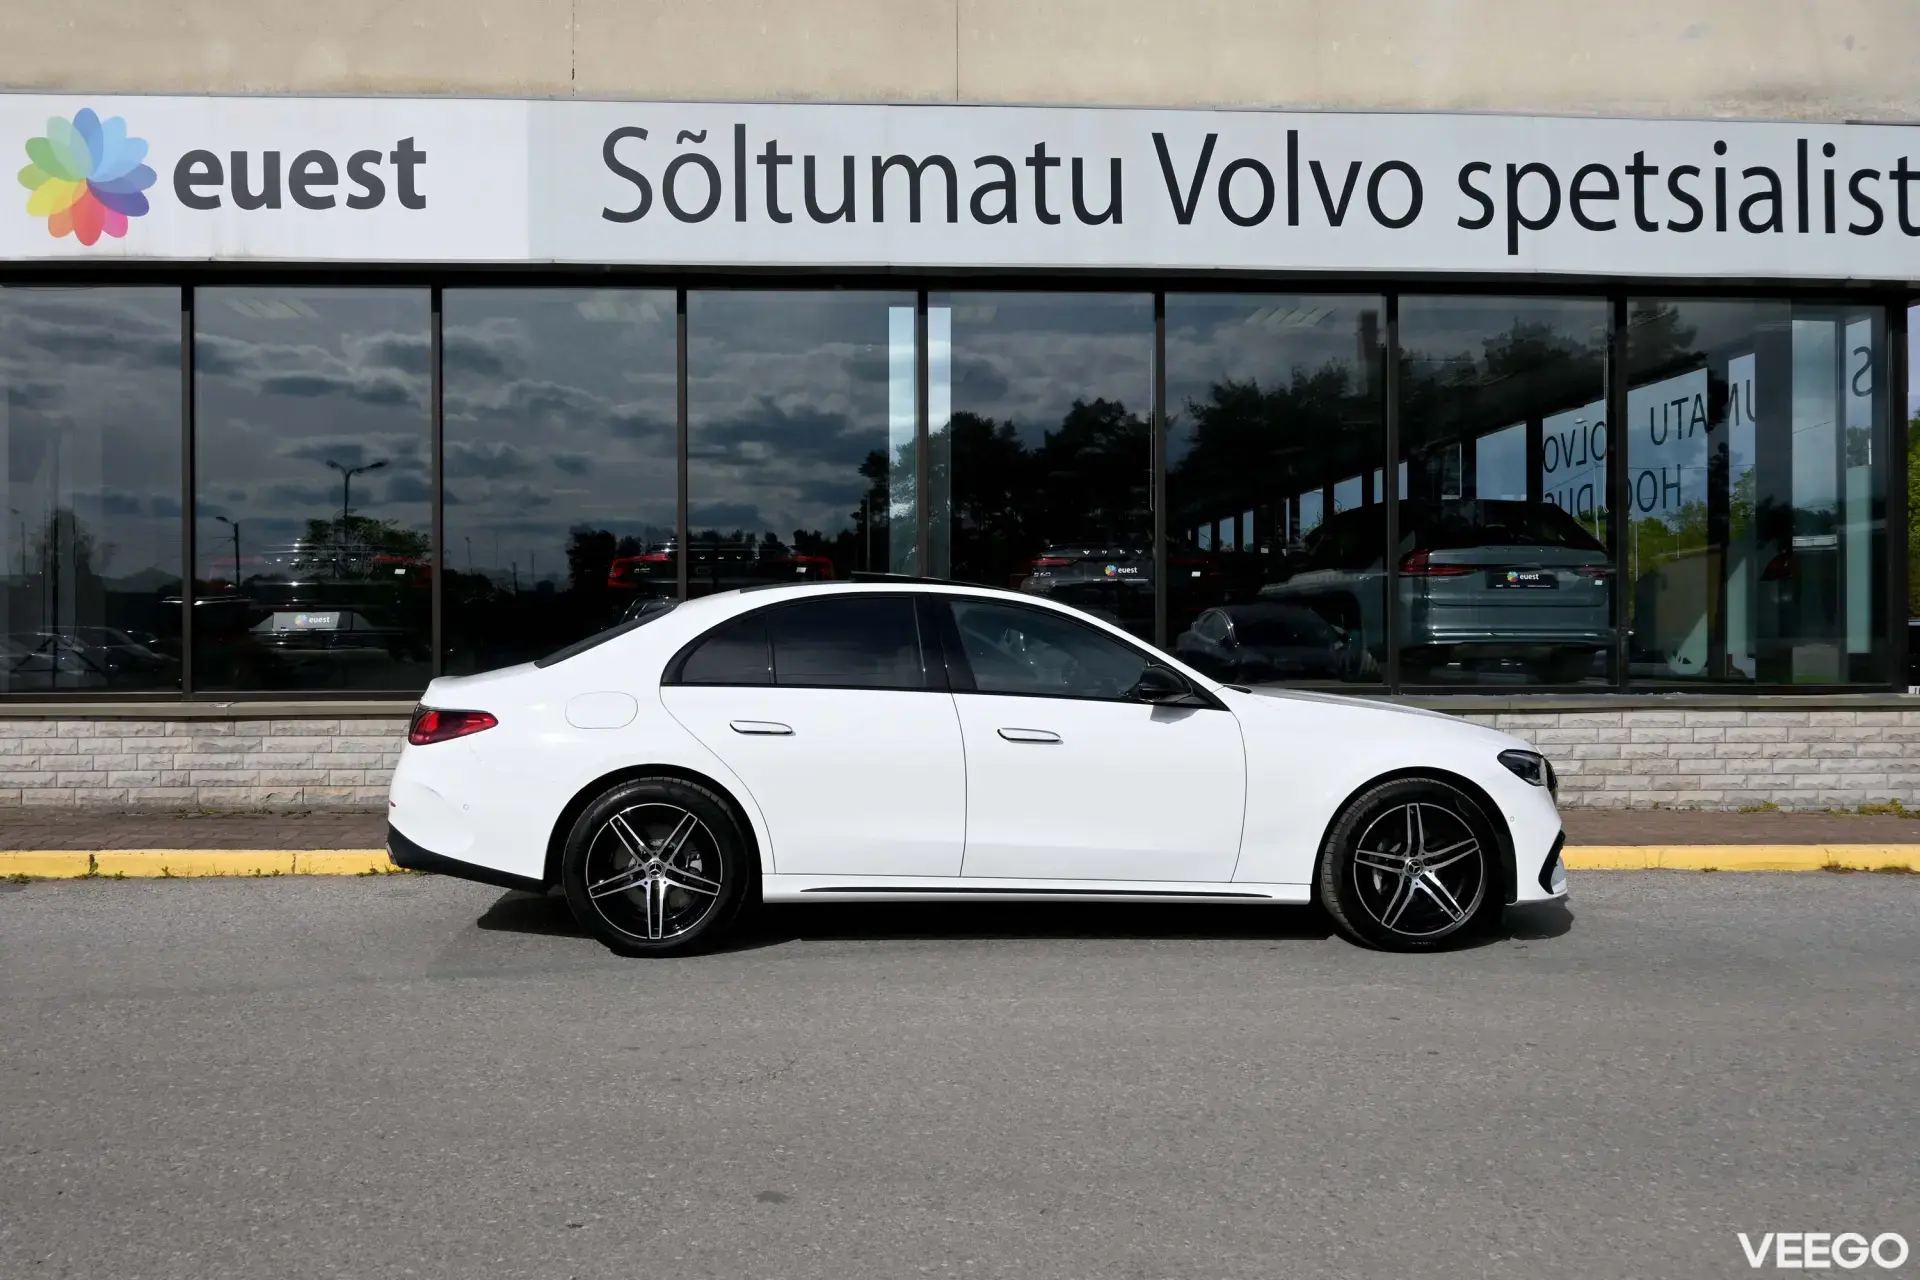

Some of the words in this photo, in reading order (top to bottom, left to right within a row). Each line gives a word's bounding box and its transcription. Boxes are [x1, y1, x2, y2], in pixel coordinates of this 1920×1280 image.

[173, 137, 427, 211] euest
[601, 124, 1123, 226] Sõltumatu
[1151, 130, 1424, 230] Volvo
[1457, 139, 1920, 256] spetsialist
[1117, 566, 1138, 574] euest
